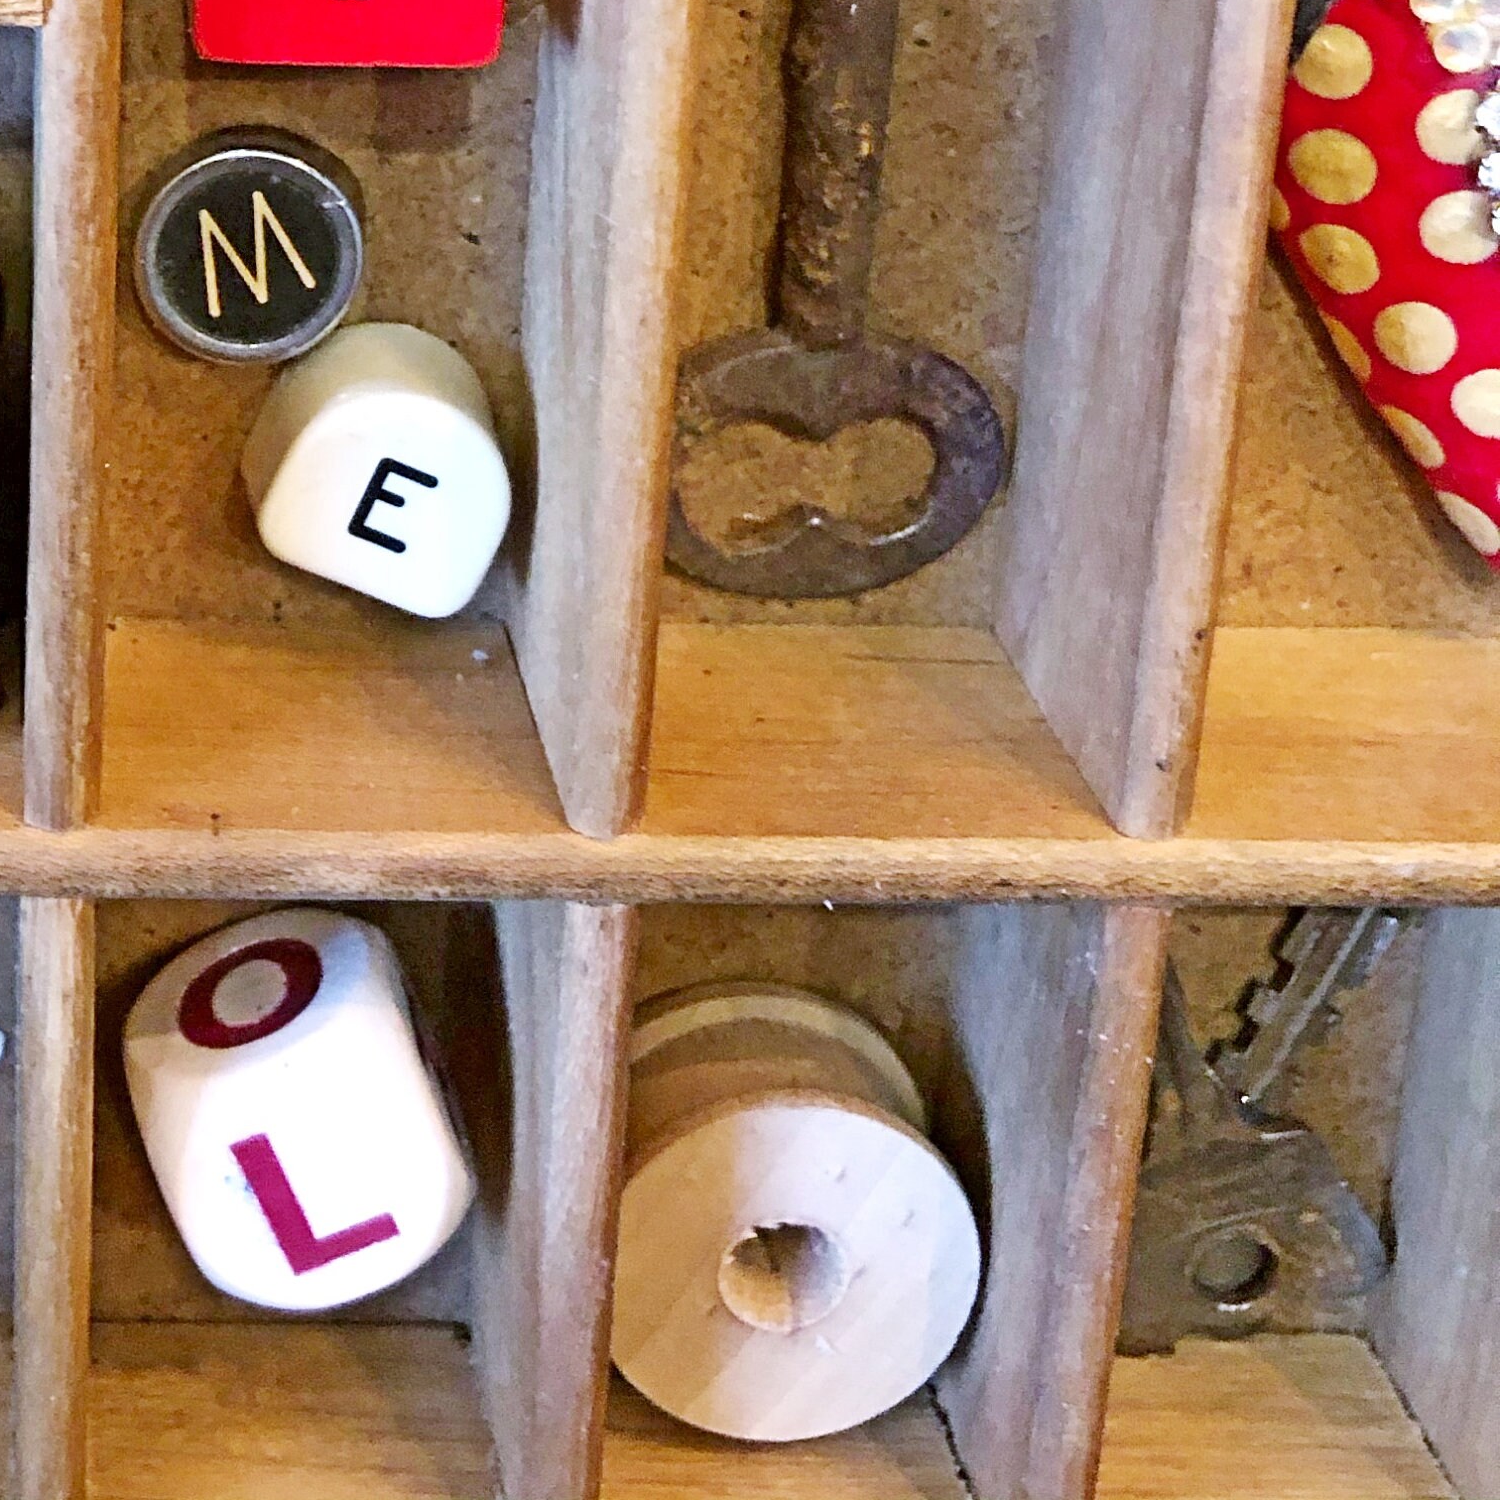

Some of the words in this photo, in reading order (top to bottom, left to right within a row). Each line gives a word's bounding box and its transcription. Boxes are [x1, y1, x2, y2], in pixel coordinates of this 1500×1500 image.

[198, 190, 317, 318] M
[347, 457, 440, 554] E
[176, 938, 324, 1050] O
[228, 1132, 401, 1277] L
